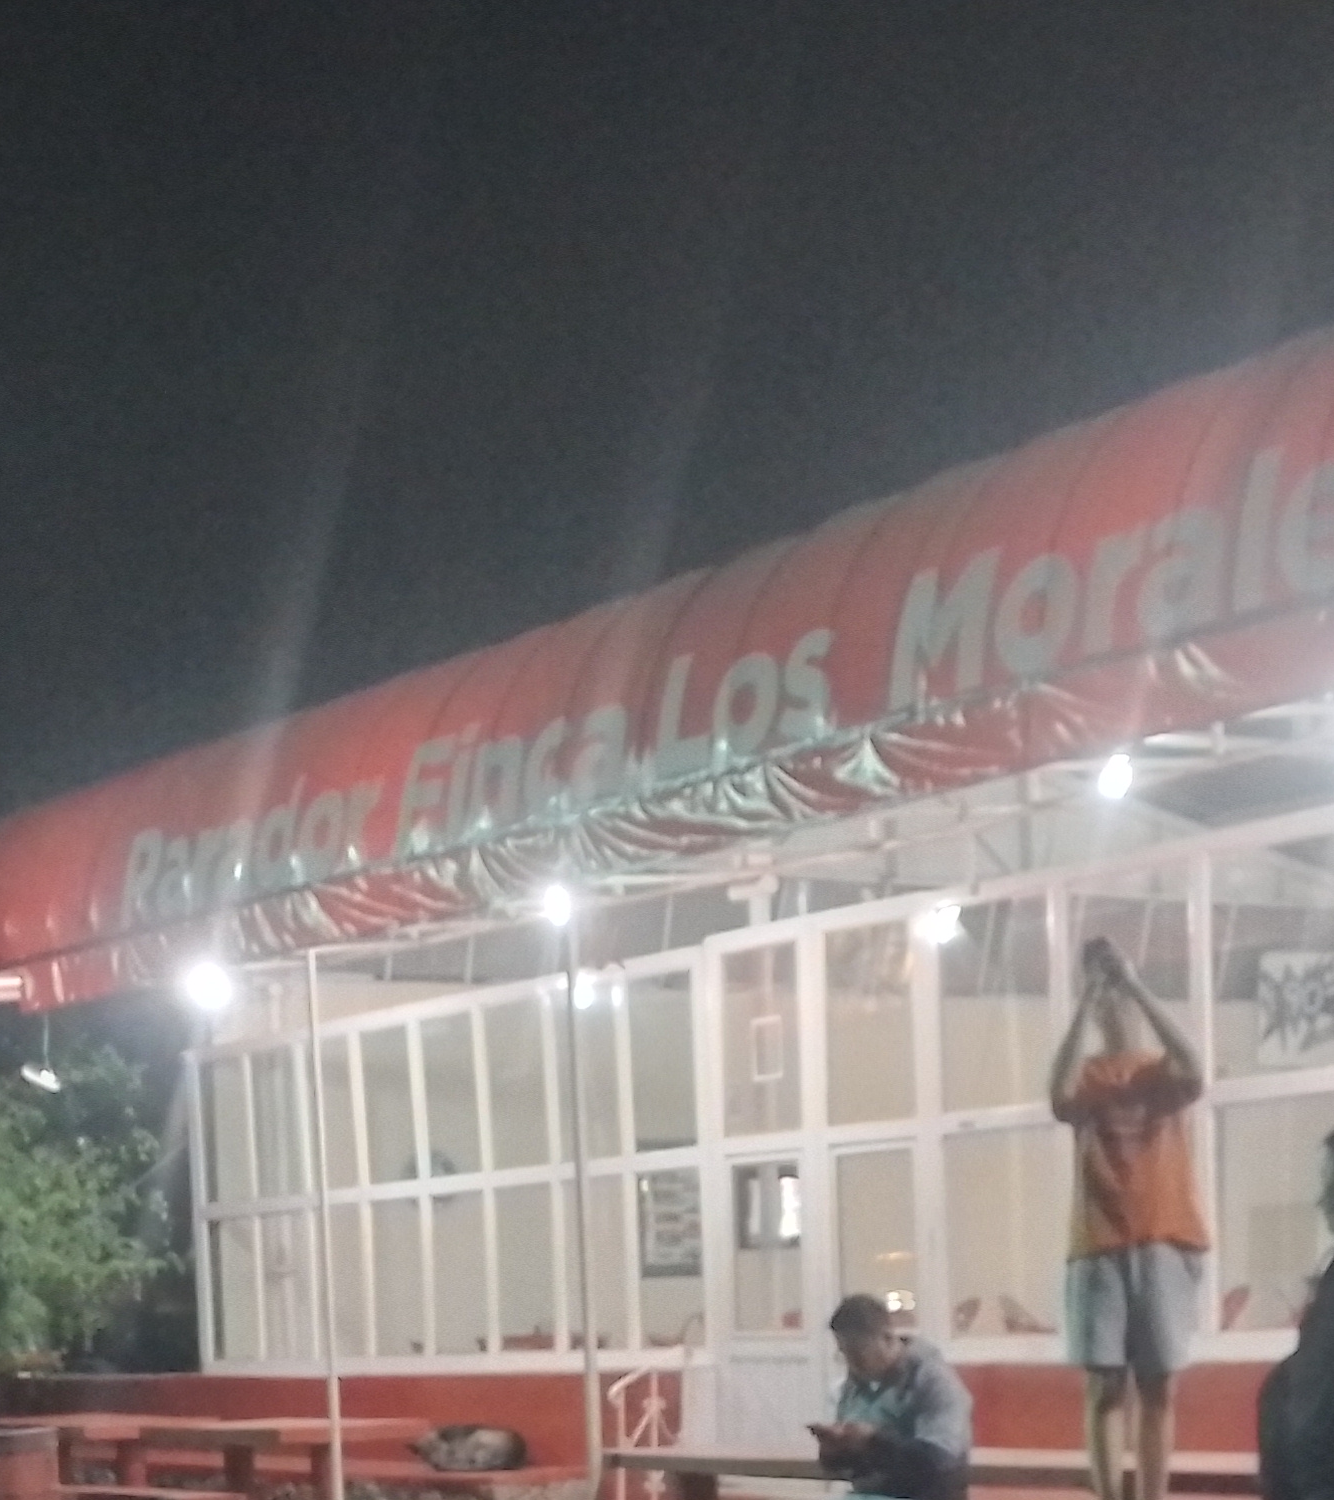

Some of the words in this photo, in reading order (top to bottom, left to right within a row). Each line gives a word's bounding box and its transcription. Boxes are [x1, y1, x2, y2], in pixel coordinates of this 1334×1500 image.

[120, 776, 385, 922] Parador
[389, 702, 627, 864] Finca
[642, 628, 835, 788] Los
